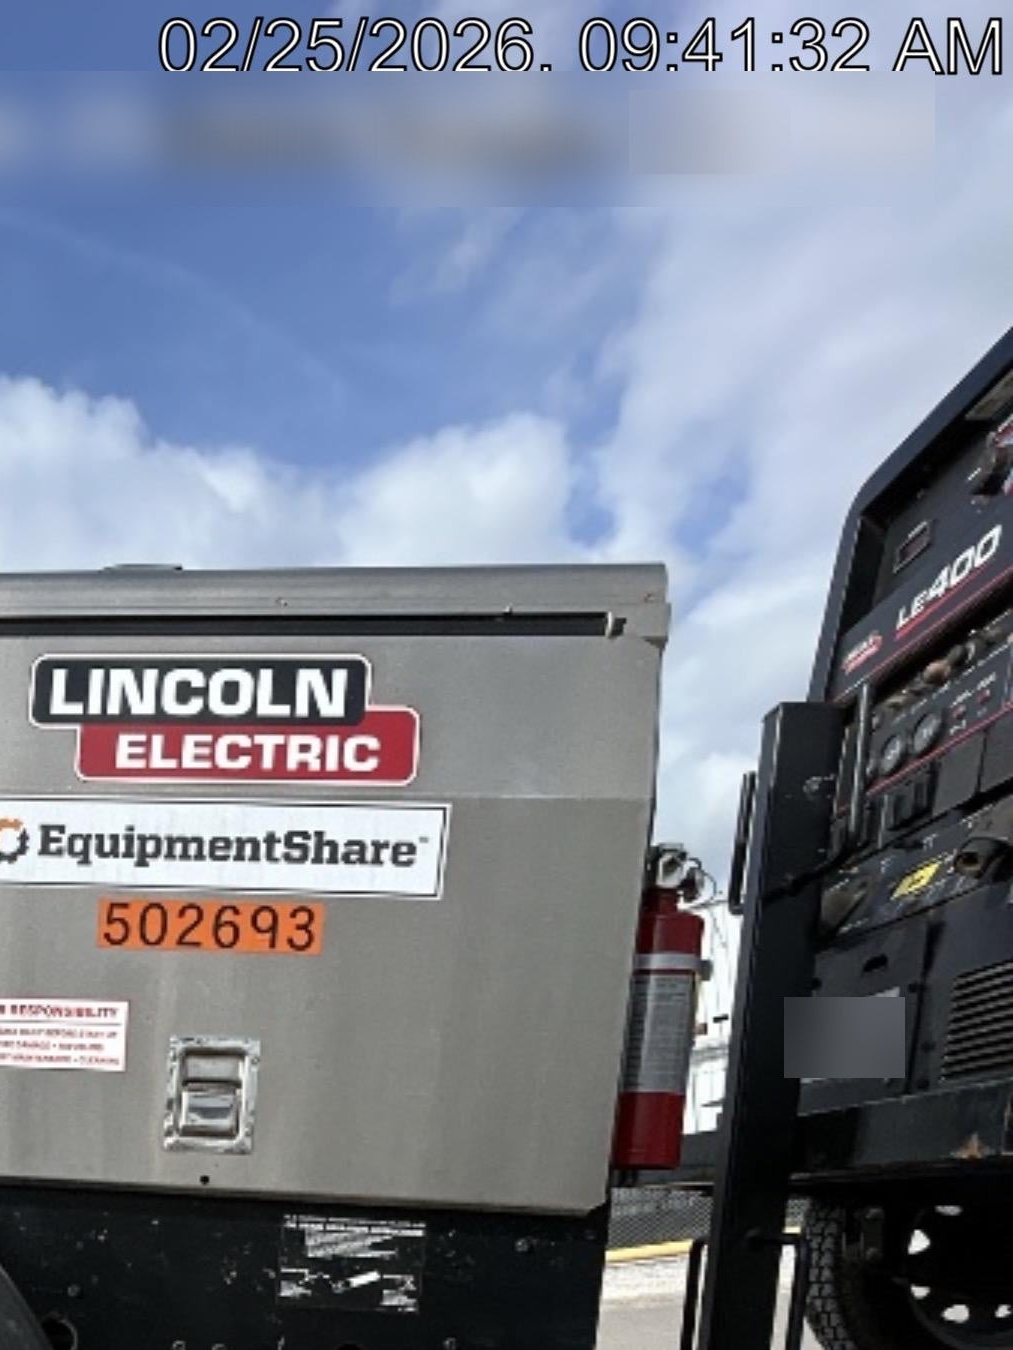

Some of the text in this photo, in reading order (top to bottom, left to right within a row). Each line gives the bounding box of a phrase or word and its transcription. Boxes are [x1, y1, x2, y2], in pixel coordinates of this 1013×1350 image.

[896, 523, 1003, 631] LE400
[49, 667, 349, 719] LINCOLN
[114, 733, 381, 773] ELECTRIC
[102, 902, 316, 952] 502693
[10, 1003, 119, 1018] RESPONSIBILITY
